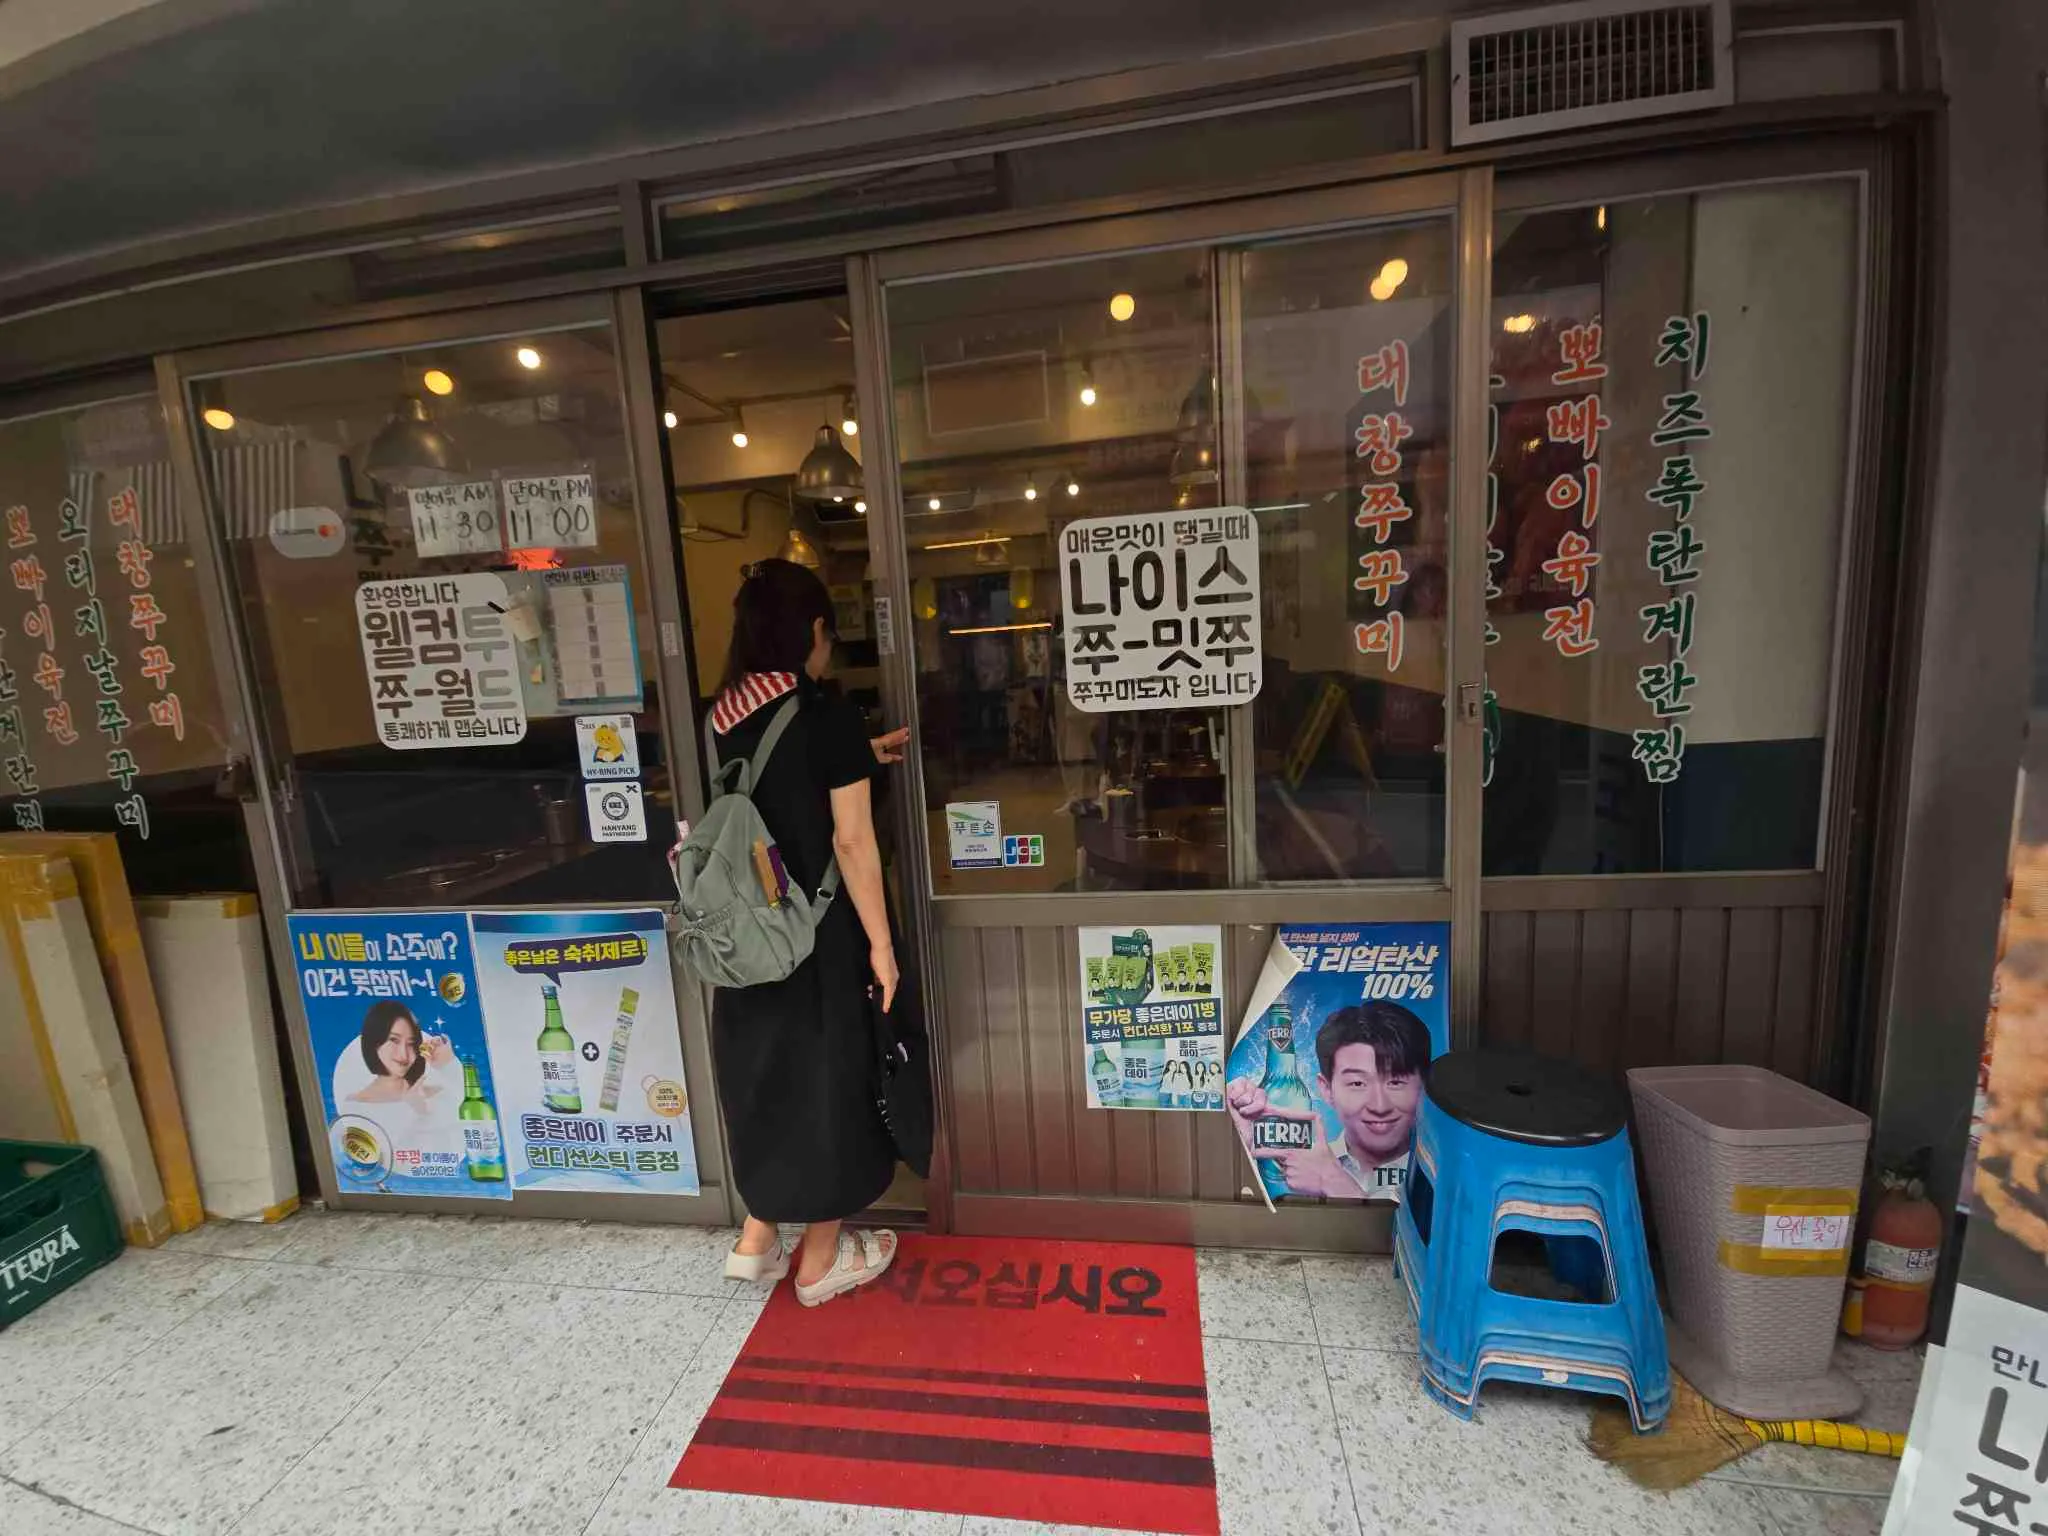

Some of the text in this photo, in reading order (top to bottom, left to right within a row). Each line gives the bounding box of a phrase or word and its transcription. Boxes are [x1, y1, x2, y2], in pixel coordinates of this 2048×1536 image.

[464, 484, 490, 502] AM
[567, 478, 591, 499] PM
[1542, 324, 1611, 658] 뽀빠이육전
[1354, 339, 1413, 673] 대창쭈꾸미
[1066, 515, 1249, 553] 매운맛이 땡길때
[1632, 313, 1711, 783] 치즈폭탄계란찜
[1069, 545, 1253, 616] 나이스
[362, 582, 460, 609] 환영합니다
[6, 505, 79, 744] 뽀빠이육전
[108, 486, 183, 740] 대창쭈꾸미
[364, 606, 509, 670] 웰컴투
[1072, 615, 1254, 676] 쭈-밋쭈
[58, 498, 150, 840] 오리지날쭈꾸미
[374, 668, 517, 719] 쭈-월드
[1188, 672, 1256, 697] 입니다
[384, 717, 520, 741] 통쾌하게 맵습니다
[299, 931, 458, 961] 내 이름이 소주에?
[1318, 946, 1439, 972] 리얼탄산
[304, 968, 348, 996] 이건
[1361, 973, 1434, 999] 100%
[1090, 1008, 1131, 1026] 무가당
[1092, 1029, 1120, 1039] 주문시
[1174, 1022, 1194, 1034] 1포
[1125, 1068, 1147, 1079] 데이
[526, 1117, 673, 1143] 좋은데이 주문시
[1256, 1121, 1311, 1145] TERRA
[528, 1147, 679, 1171] 컨디션스틱 증정
[0, 1224, 80, 1290] TERRA
